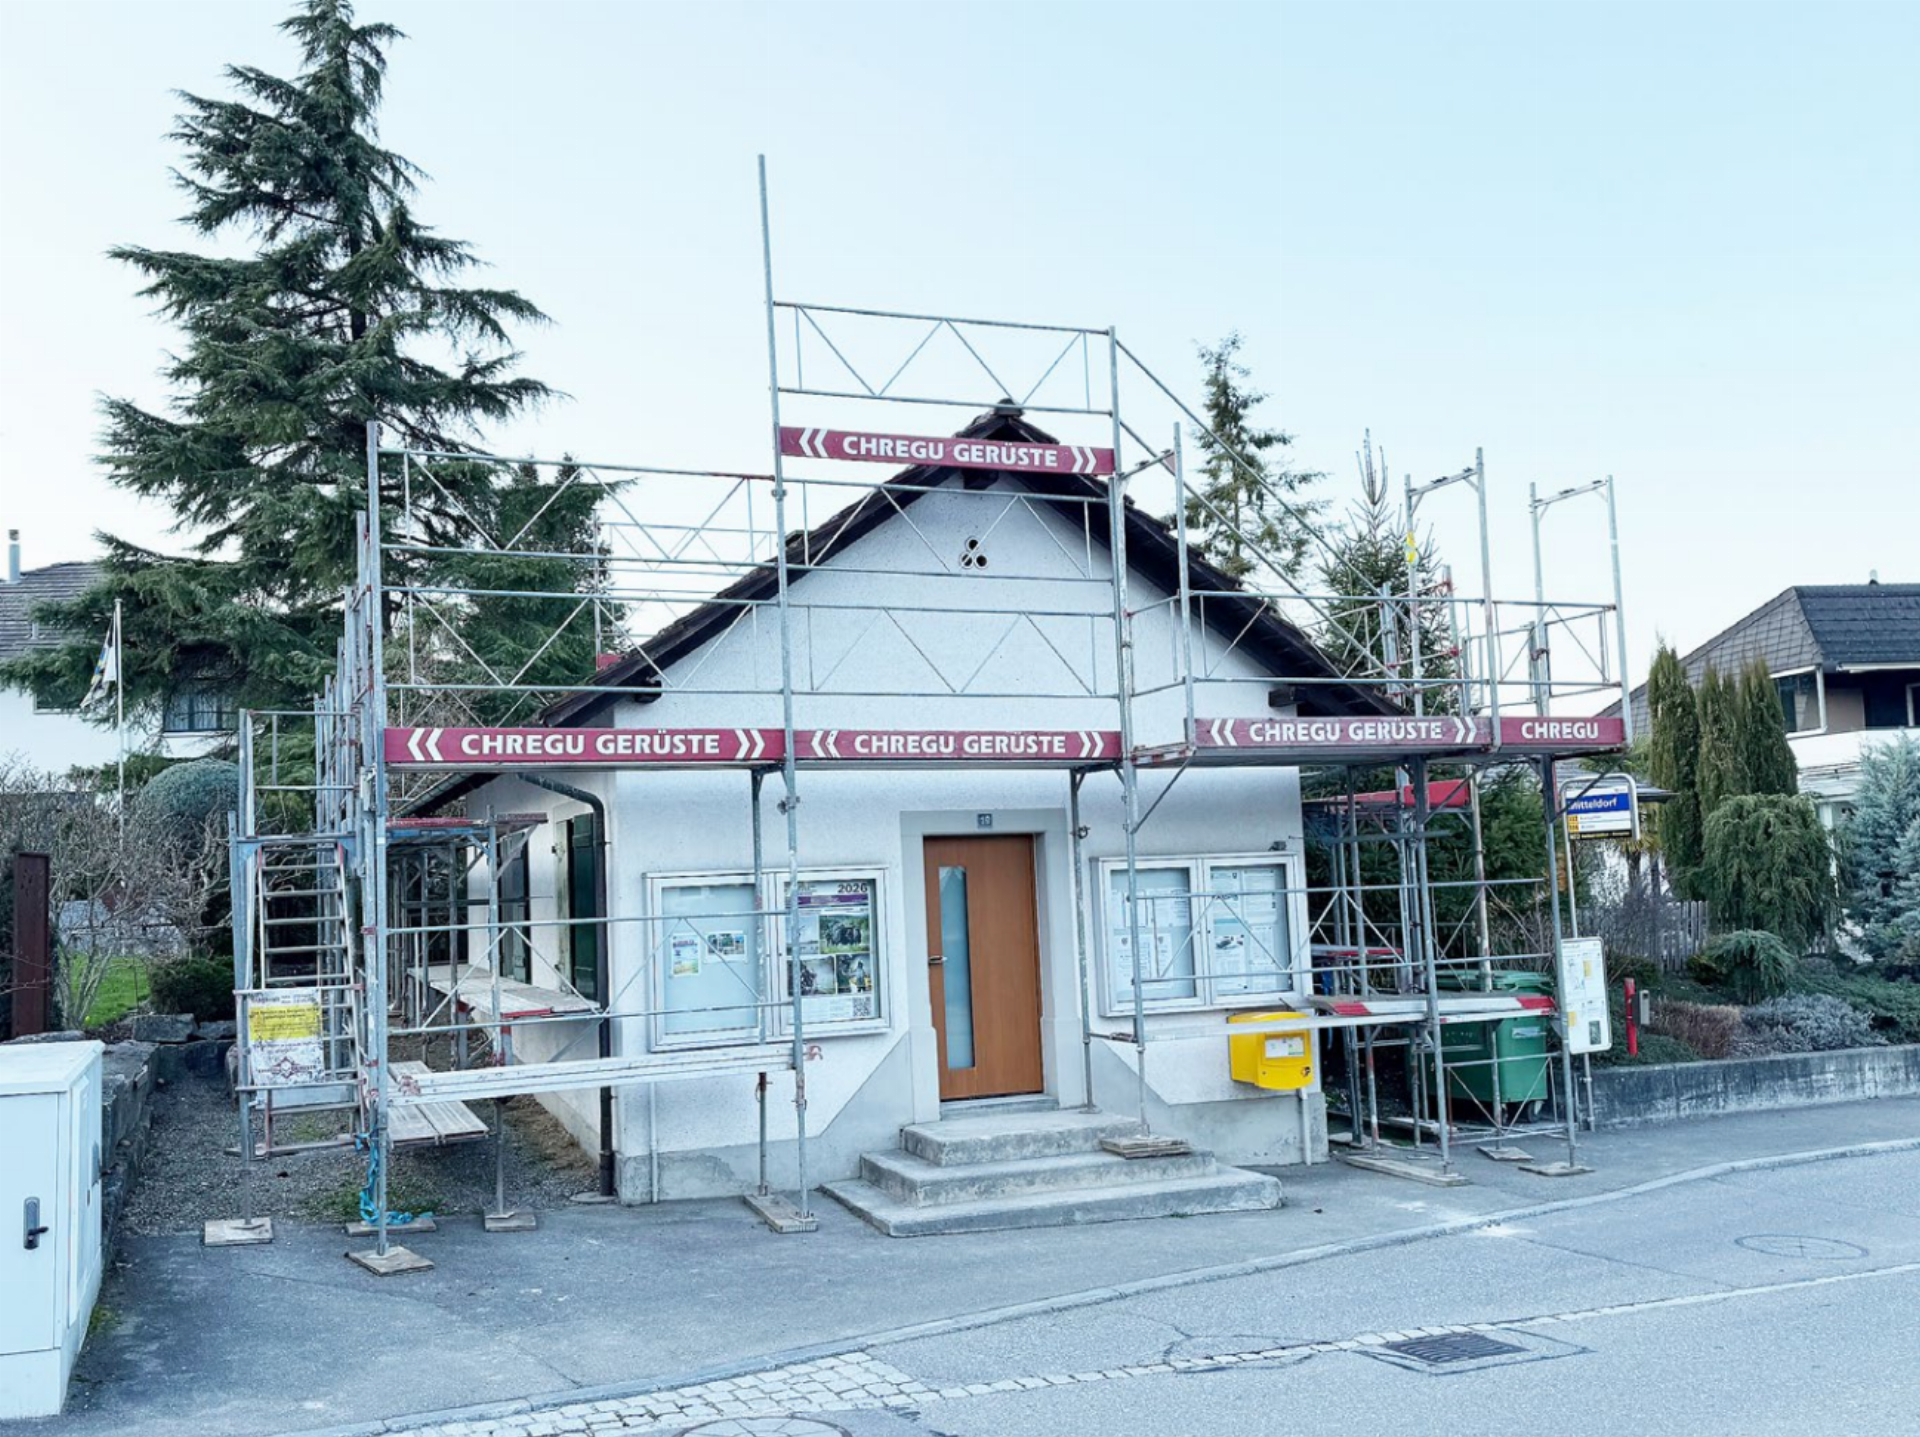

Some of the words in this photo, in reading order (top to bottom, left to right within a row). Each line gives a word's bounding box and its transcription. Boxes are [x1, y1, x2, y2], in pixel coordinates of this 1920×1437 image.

[842, 435, 944, 461] CHREGU
[953, 442, 1058, 467] GERÜSTE
[1249, 720, 1341, 742] CHREGU
[1348, 717, 1443, 741] GERÜSTE
[1521, 720, 1599, 740] CHREGU
[461, 733, 585, 755] CHREGU
[595, 730, 720, 755] GERÜSTE
[854, 734, 954, 754] CHREGU
[962, 730, 1066, 754] GERÜSTE
[837, 882, 868, 893] 2026
